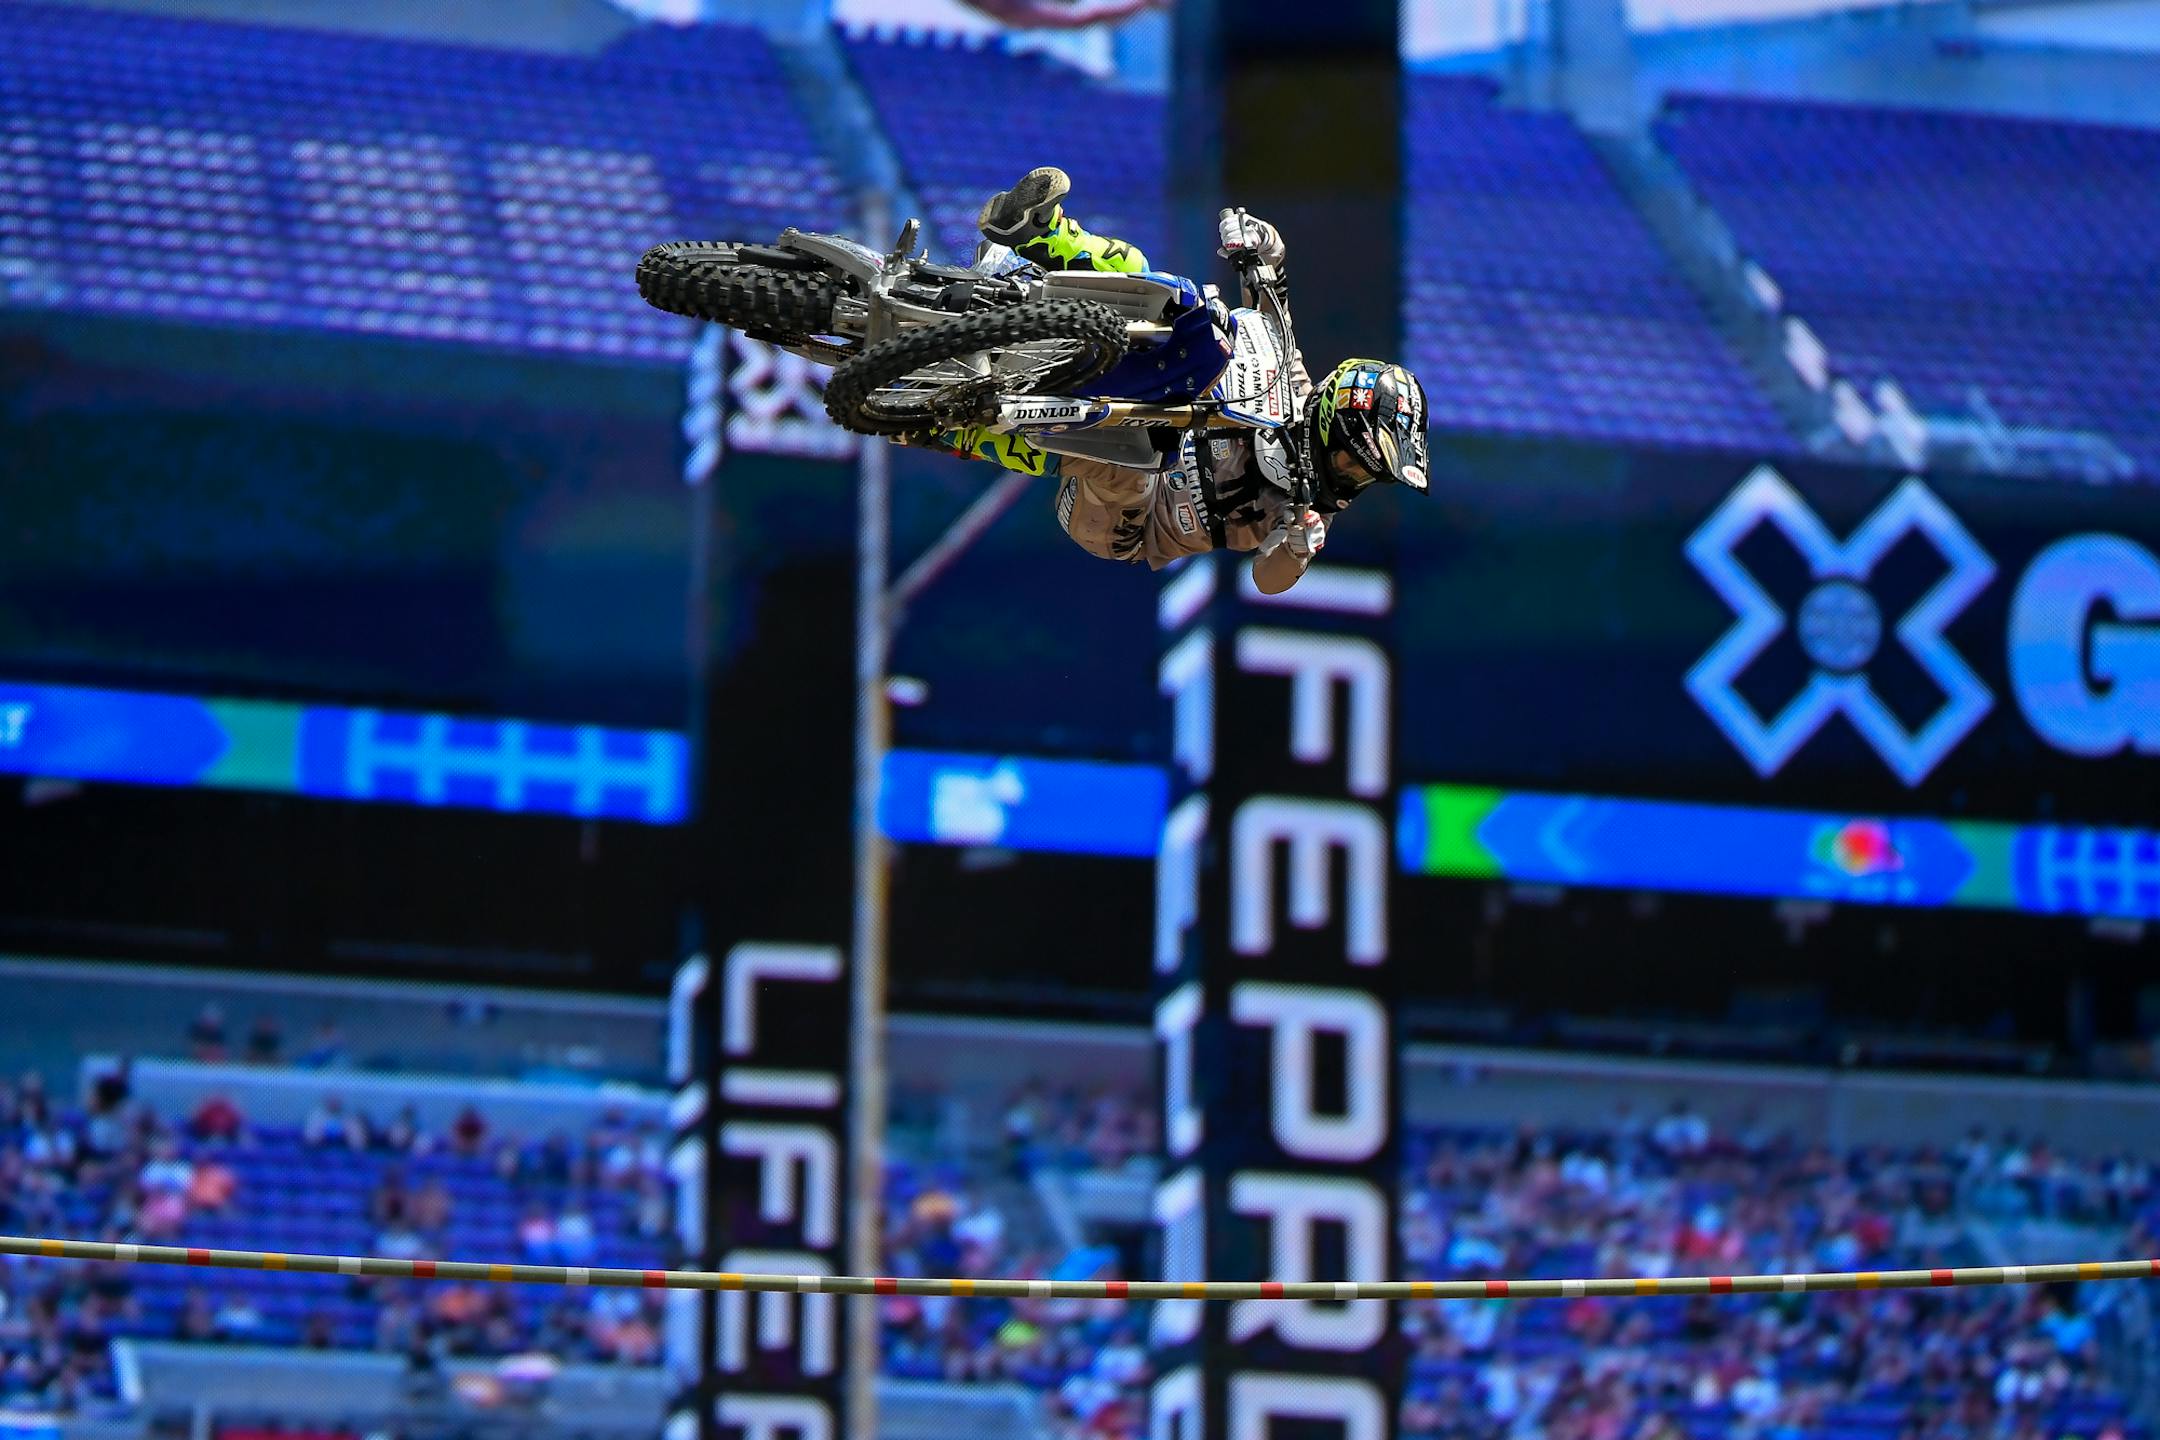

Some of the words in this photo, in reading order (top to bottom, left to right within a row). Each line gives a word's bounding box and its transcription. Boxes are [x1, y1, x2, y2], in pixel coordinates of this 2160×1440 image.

[1267, 371, 1279, 415] MOTUL
[1014, 406, 1080, 420] DUNLOP
[1179, 506, 1194, 531] 100%
